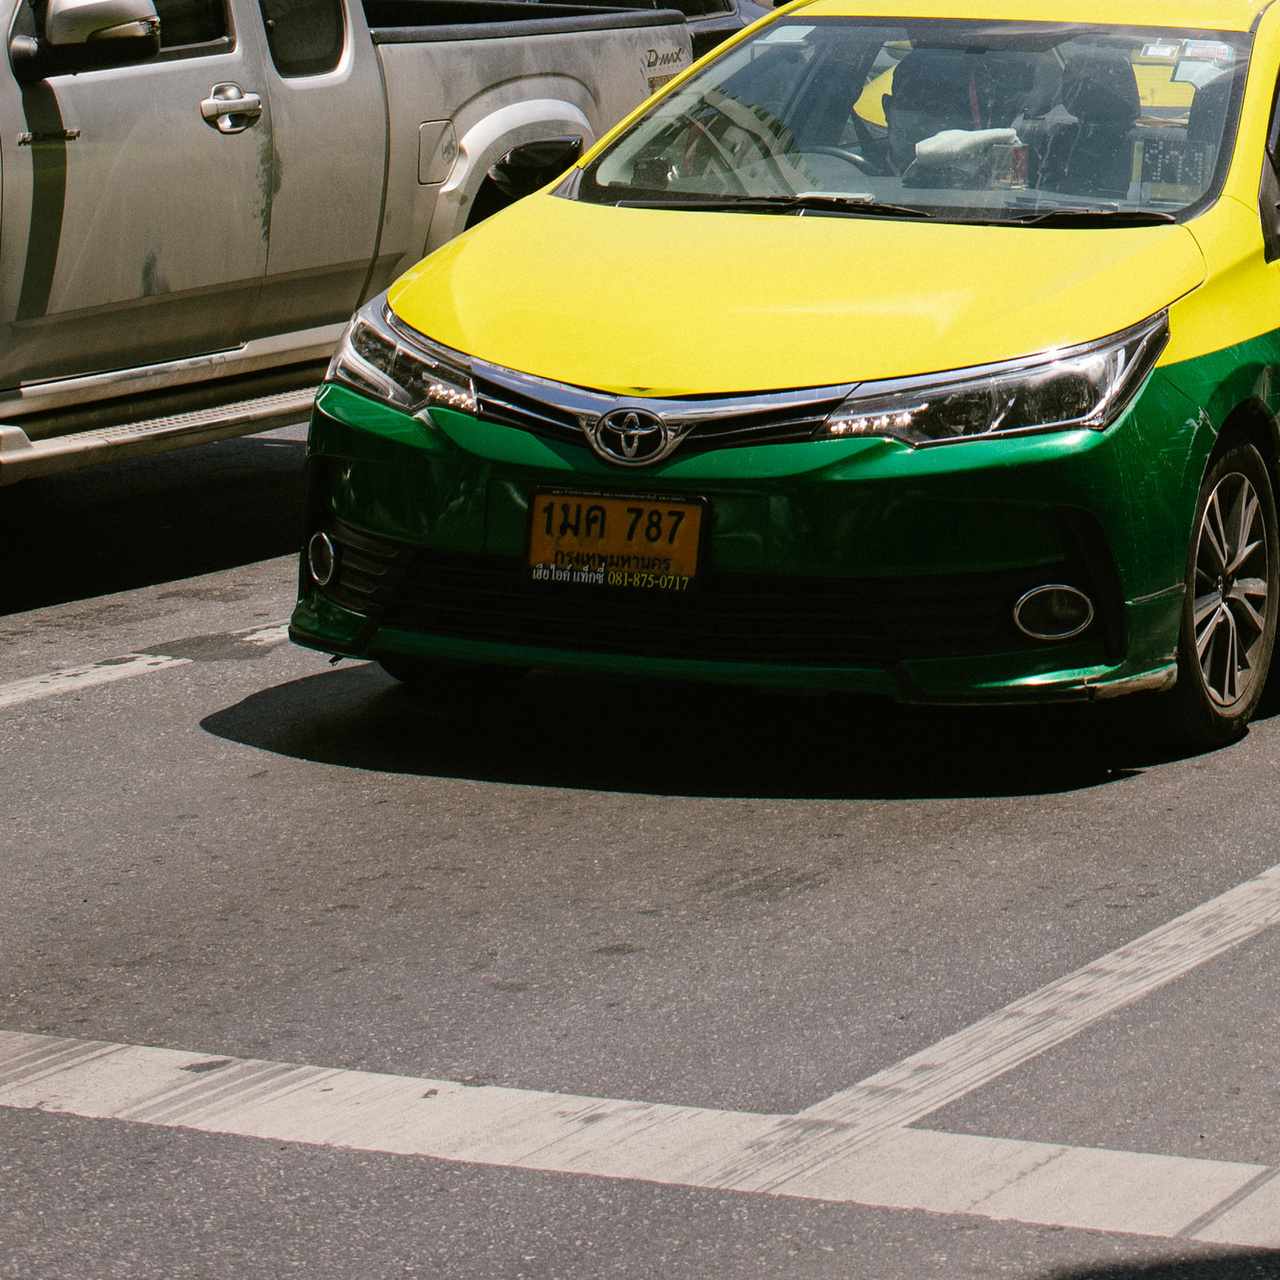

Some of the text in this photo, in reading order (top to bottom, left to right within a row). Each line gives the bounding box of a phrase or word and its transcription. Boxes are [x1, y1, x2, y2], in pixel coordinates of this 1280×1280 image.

[542, 502, 685, 545] 1มค 787
[555, 550, 671, 572] กรงเทพมหานคร
[607, 571, 689, 590] 081-875-0717
